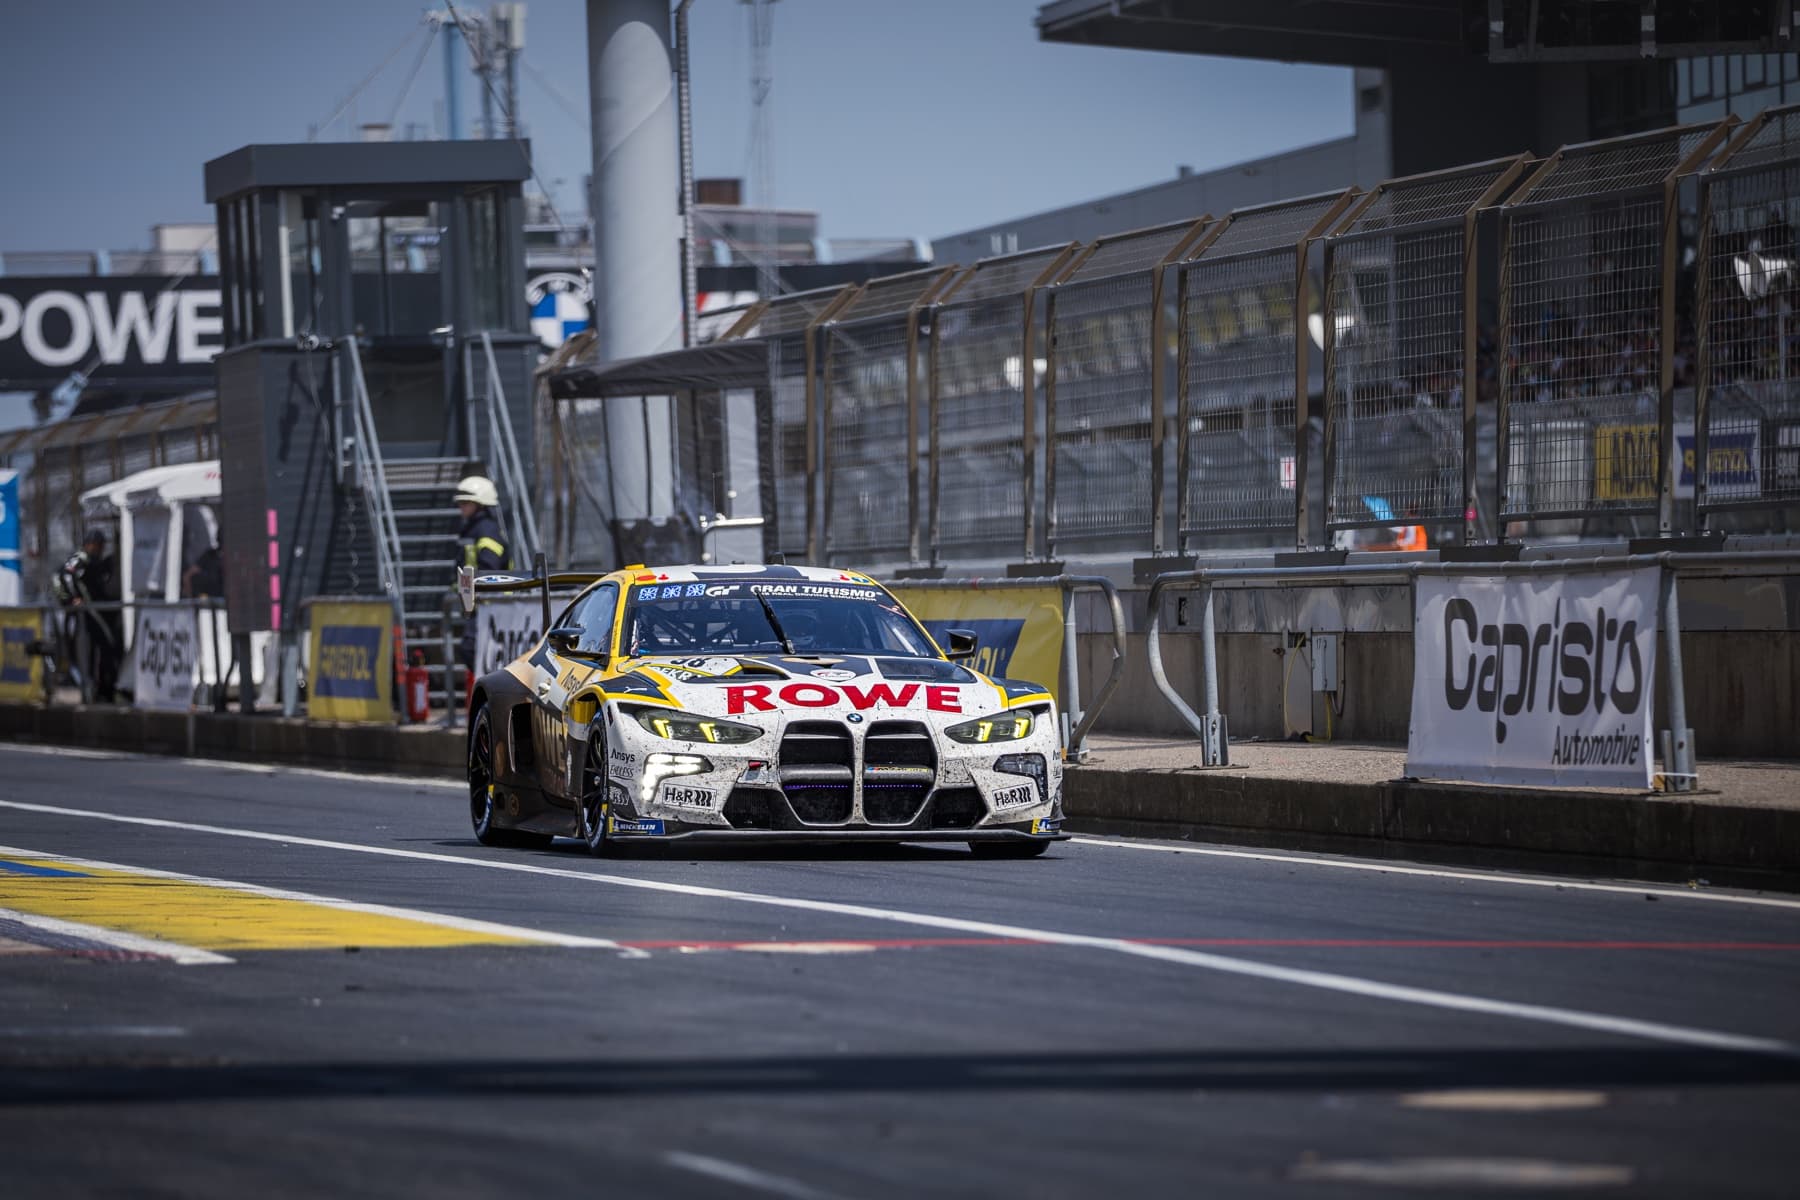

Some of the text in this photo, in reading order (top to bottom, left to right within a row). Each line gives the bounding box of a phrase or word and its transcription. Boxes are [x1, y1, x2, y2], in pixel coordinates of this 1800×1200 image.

[750, 585, 797, 597] GRAN
[1445, 597, 1642, 744] Capristo
[724, 684, 964, 714] ROWE
[610, 748, 636, 764] Ansys
[1551, 724, 1640, 766] Automotive
